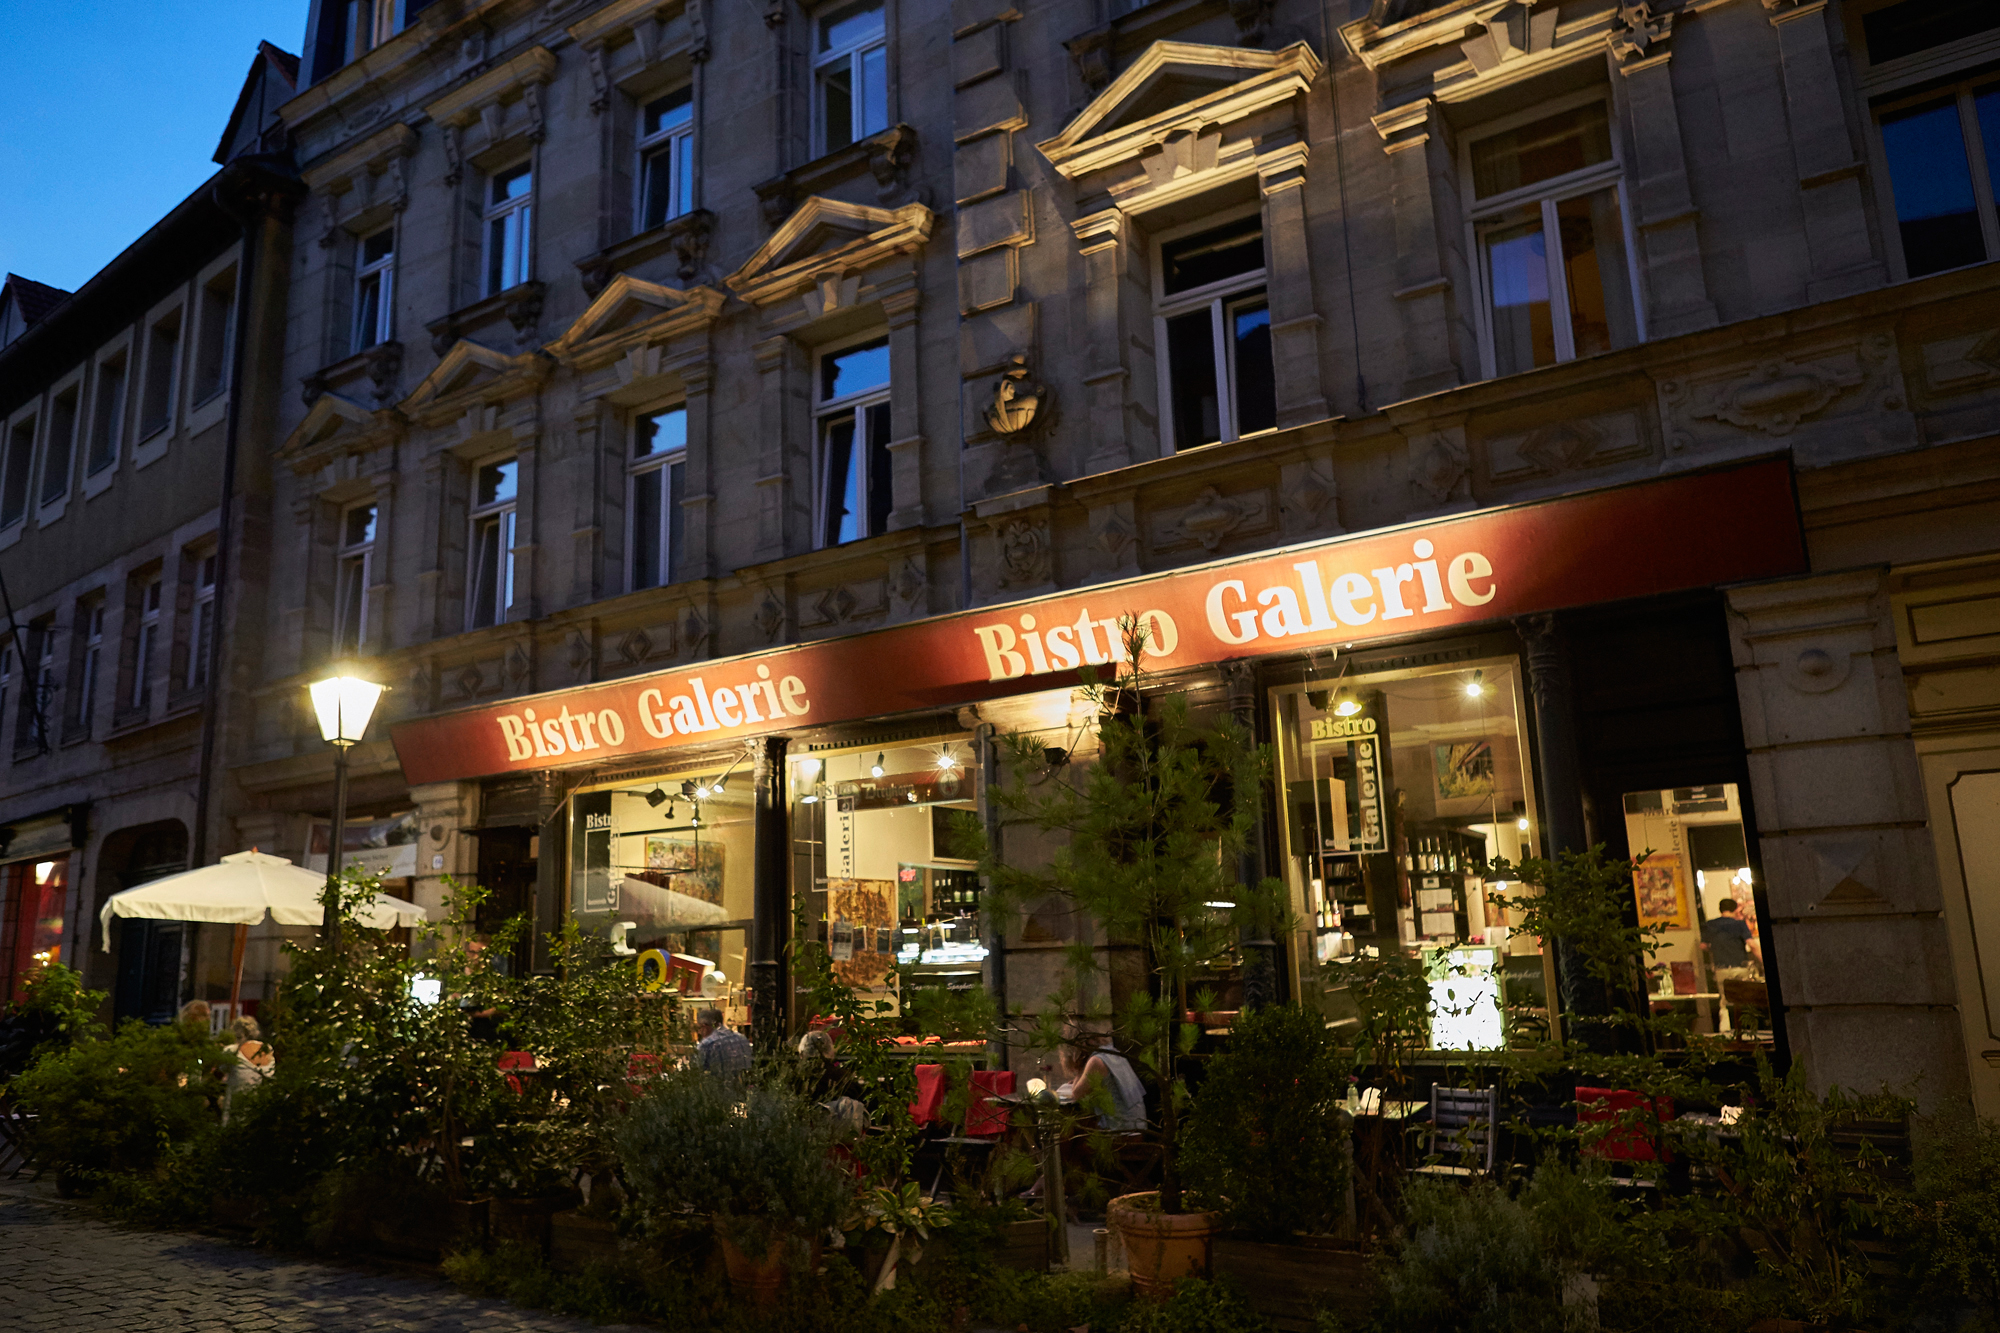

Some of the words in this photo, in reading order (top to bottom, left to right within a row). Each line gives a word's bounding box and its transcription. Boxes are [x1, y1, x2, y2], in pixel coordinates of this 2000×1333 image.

[974, 607, 1179, 683] Bistro
[1205, 539, 1497, 646] Galerie
[497, 704, 625, 762] Bistro
[638, 664, 811, 739] Galerie
[1310, 716, 1377, 740] Bistro
[840, 801, 851, 882] Galerie
[1357, 742, 1380, 845] Galerie
